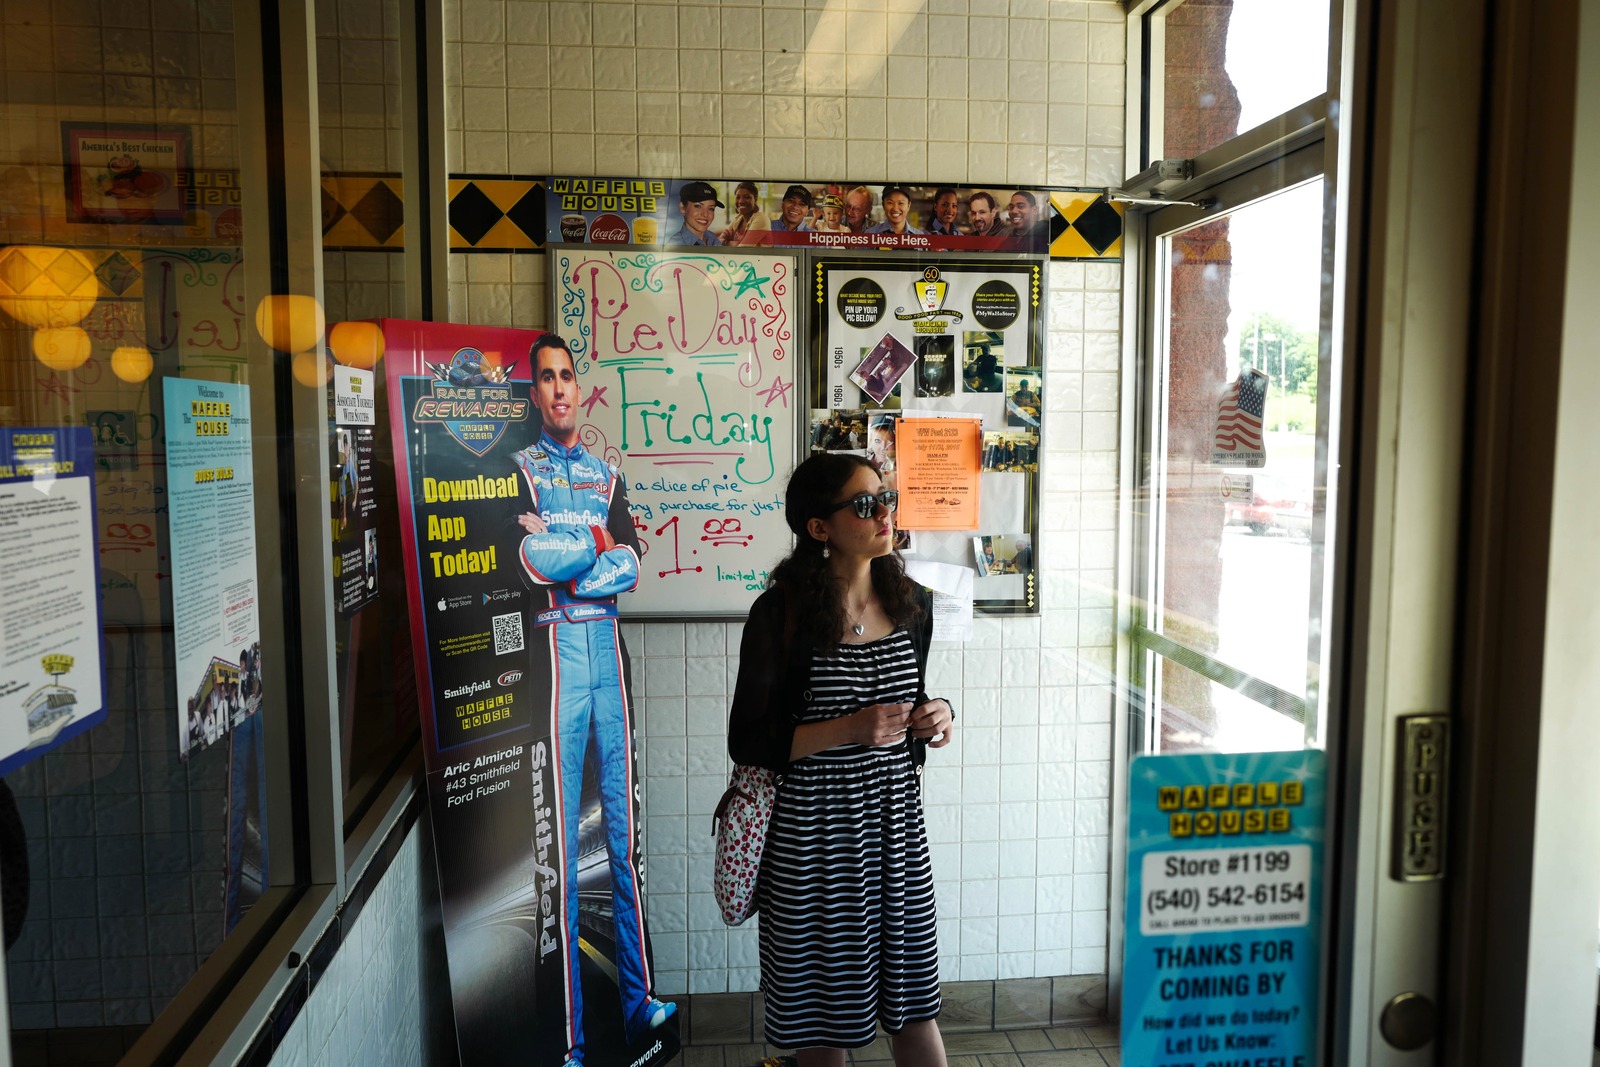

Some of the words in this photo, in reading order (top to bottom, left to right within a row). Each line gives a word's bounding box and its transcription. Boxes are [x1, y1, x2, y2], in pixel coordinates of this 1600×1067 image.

[81, 140, 120, 152] AMERICA'S
[122, 141, 140, 153] BEST
[142, 142, 174, 153] CHICKEN
[554, 179, 665, 195] WAFFLE
[562, 195, 656, 212] HOUSE
[809, 232, 869, 246] Happiness
[871, 234, 899, 246] Lives
[901, 234, 932, 246] Here.
[925, 268, 938, 279] 60
[845, 305, 855, 314] PIN
[855, 306, 863, 314] UP
[863, 306, 878, 314] YOUR
[846, 314, 855, 322] PIC
[855, 314, 877, 322] BELOW!
[573, 259, 664, 361] Pie
[649, 262, 763, 388] Day
[834, 346, 844, 369] 1950s
[197, 385, 218, 398] Welcome
[337, 393, 356, 407] ASSOCIATE
[357, 394, 374, 408] YOURSELF
[436, 387, 476, 400] RACE
[481, 389, 509, 400] FOR
[833, 384, 844, 407] 1960s
[182, 413, 191, 424] The
[191, 400, 231, 417] WAFFLE
[343, 408, 354, 421] WITH
[355, 409, 369, 422] SUCCESS
[418, 400, 525, 418] REWARDS
[196, 420, 229, 436] HOUSE
[459, 424, 495, 432] WAFFLE
[617, 366, 775, 485] Friday
[463, 432, 493, 440] HOUSE
[194, 469, 214, 483] HOUSE
[215, 467, 234, 480] RULES
[635, 483, 648, 492] a
[651, 477, 687, 492] slice
[692, 478, 710, 492] of
[712, 474, 743, 496] pie
[423, 472, 519, 504] Download
[659, 499, 725, 514] purchase
[726, 498, 748, 512] for
[750, 494, 784, 516] just
[428, 514, 466, 542] App
[530, 537, 588, 554] Smithfield
[430, 545, 497, 578] Today!
[585, 558, 633, 592] Smithfield
[717, 565, 756, 582] limited
[492, 592, 511, 601] Google
[571, 607, 607, 618] Almirola
[459, 633, 482, 641] Information
[444, 680, 491, 699] Smithfield
[456, 693, 513, 717] WAFFLE
[462, 707, 511, 730] HOUSE
[444, 762, 471, 779] Aric
[474, 745, 523, 770] Almirola
[446, 776, 467, 793] #43
[469, 759, 520, 785] Smithfield
[447, 791, 473, 808] Ford
[476, 778, 510, 800] Fusion
[1159, 783, 1302, 809] WAFFLE
[1170, 809, 1290, 835] HOUSE
[531, 741, 558, 958] Smithfield
[1165, 856, 1220, 878] Store
[1227, 851, 1291, 873] #1199
[1147, 888, 1200, 915] (540)
[1207, 882, 1305, 908] 542-6154
[1153, 943, 1242, 970] THANKS
[1250, 939, 1294, 964] FOR
[1161, 974, 1249, 1001] COMING
[1257, 972, 1286, 995] BY
[1143, 1015, 1174, 1030] How
[1179, 1012, 1201, 1028] did
[1205, 1014, 1225, 1026] we
[1230, 1010, 1248, 1025] do
[1252, 1006, 1300, 1025] today?
[1166, 1037, 1192, 1055] Let
[1197, 1035, 1219, 1052] Us
[1225, 1033, 1276, 1050] Know:
